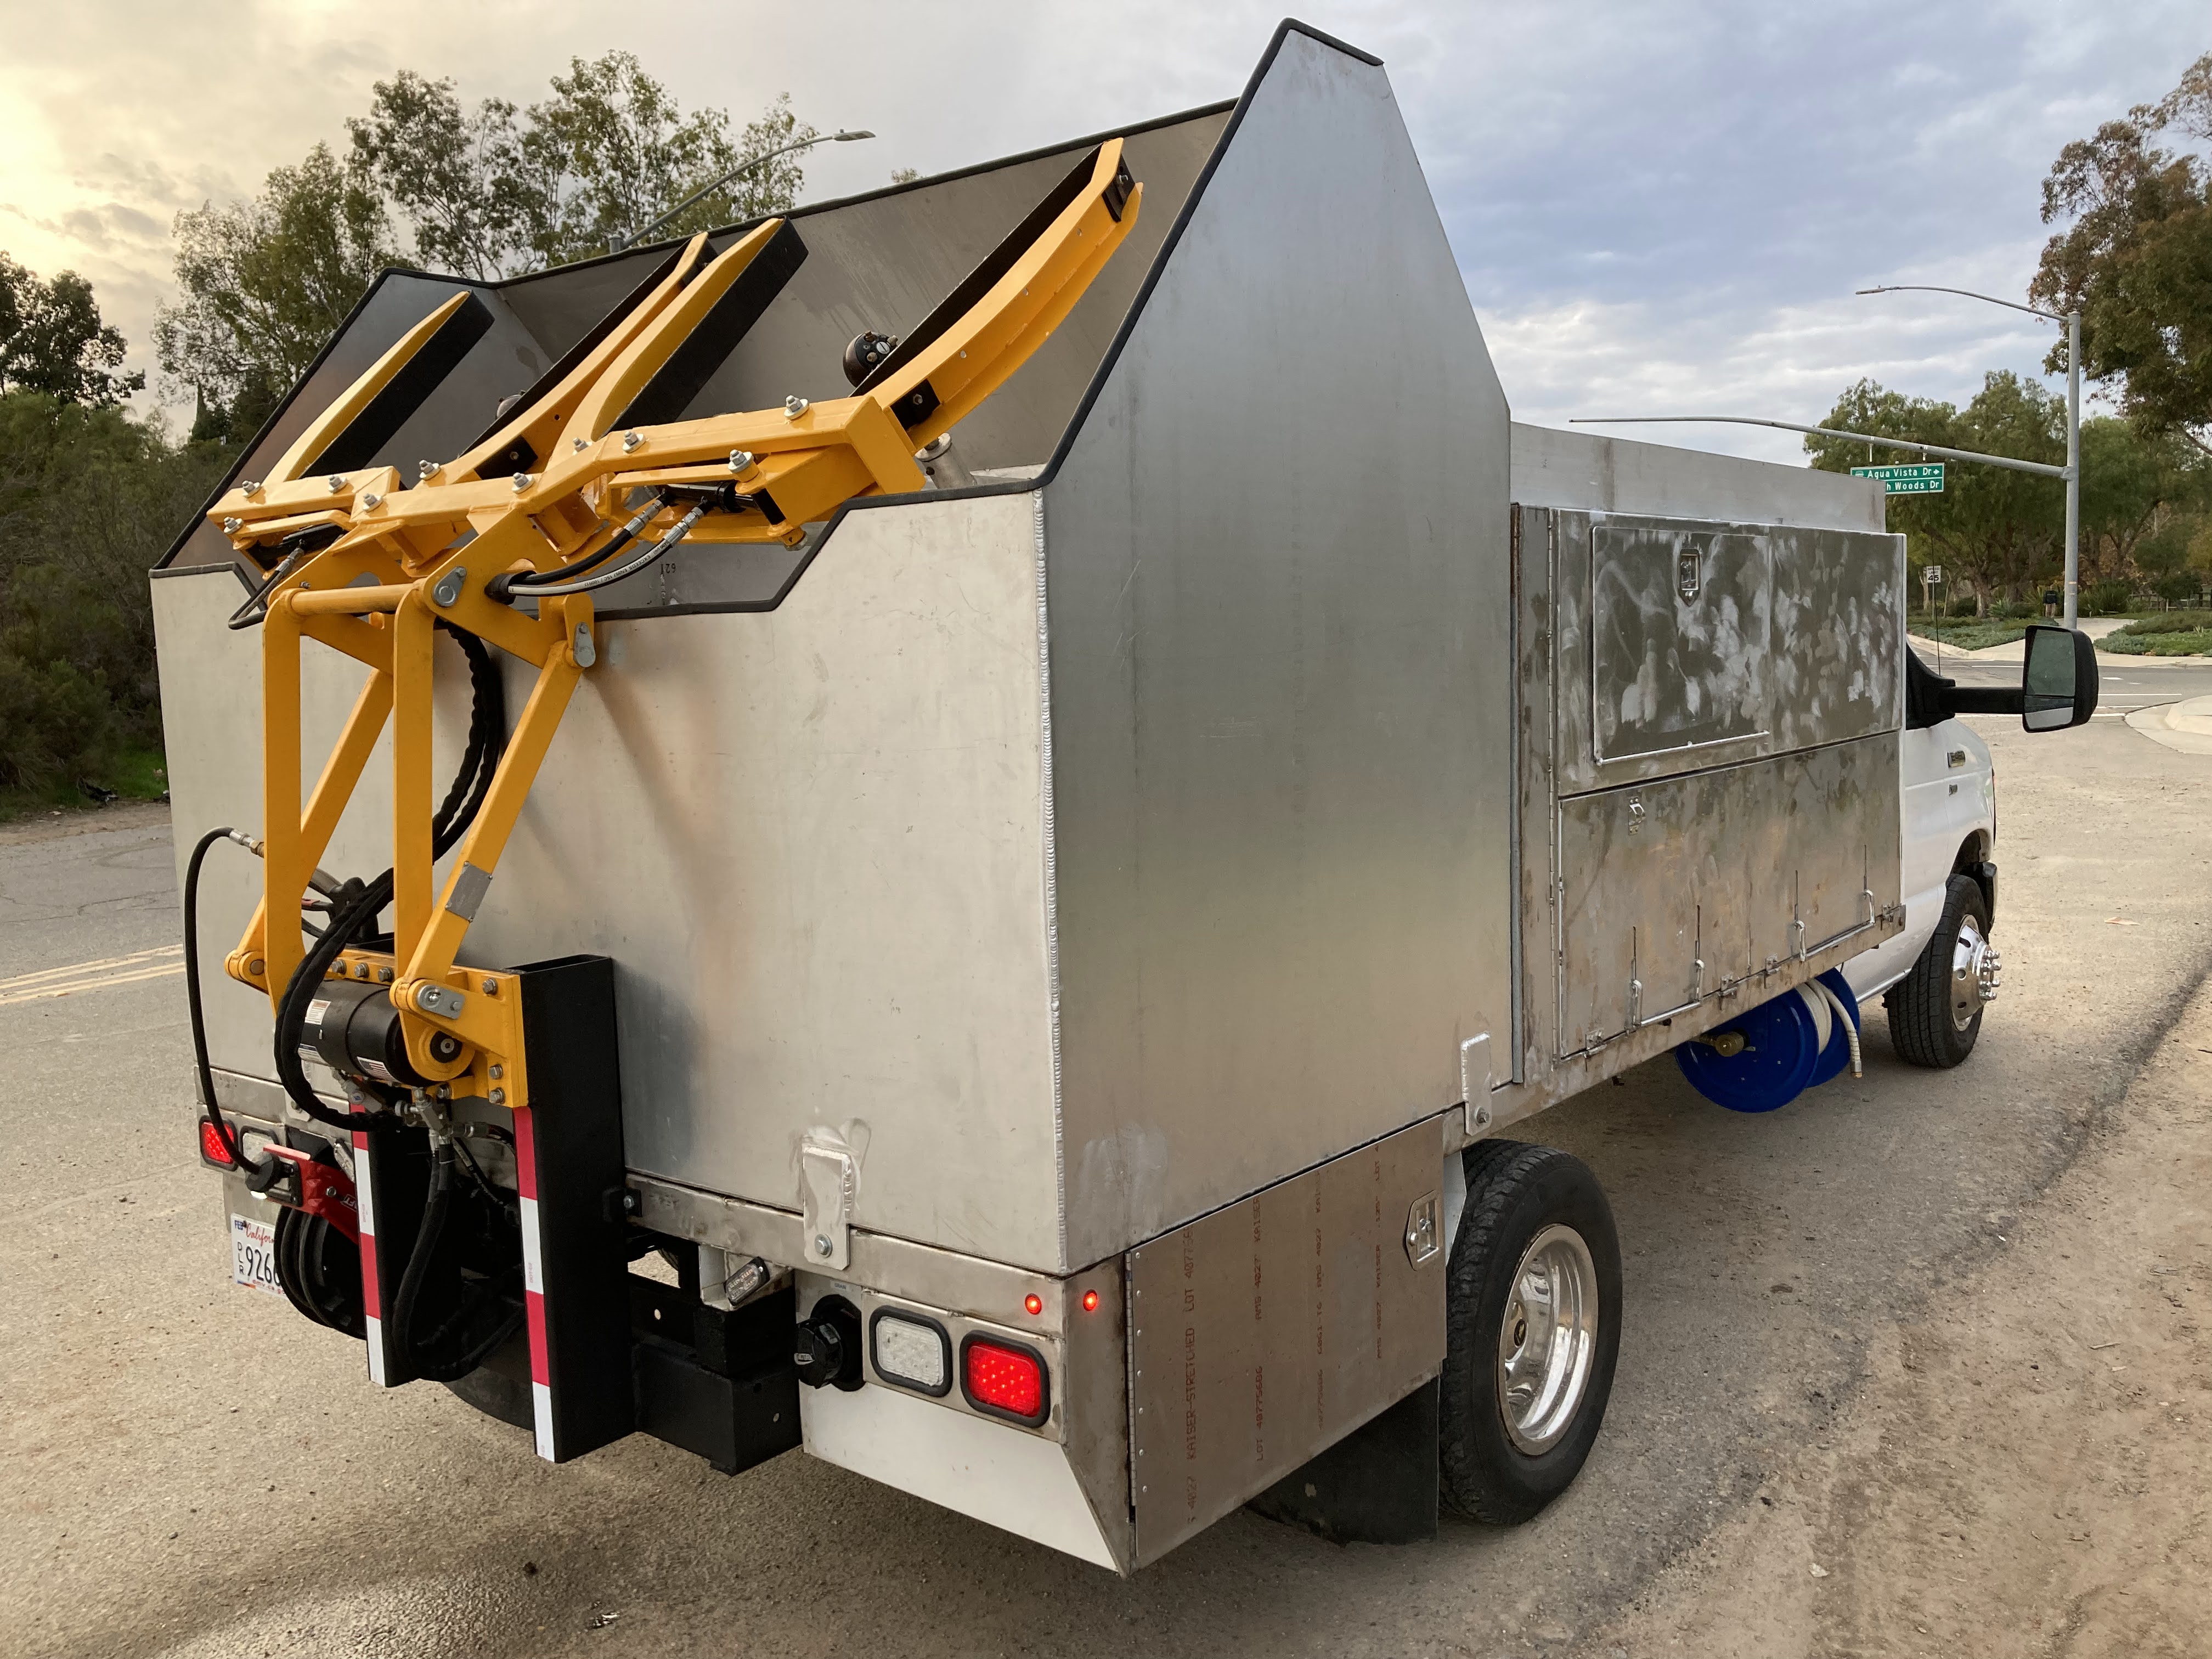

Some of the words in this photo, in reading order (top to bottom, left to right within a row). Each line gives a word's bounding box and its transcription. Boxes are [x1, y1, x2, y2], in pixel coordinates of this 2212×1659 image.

[1867, 470, 1890, 480] Agua
[1893, 468, 1918, 477] Vista
[1922, 467, 1932, 476] Dr
[1894, 481, 1925, 490] Woods
[1929, 480, 1940, 489] Dr
[629, 555, 651, 571] EXCEEDS
[1184, 1289, 1194, 1312] LOT
[1184, 1328, 1196, 1460] KAISER-STRETCHED
[1187, 1476, 1197, 1510] 4027
